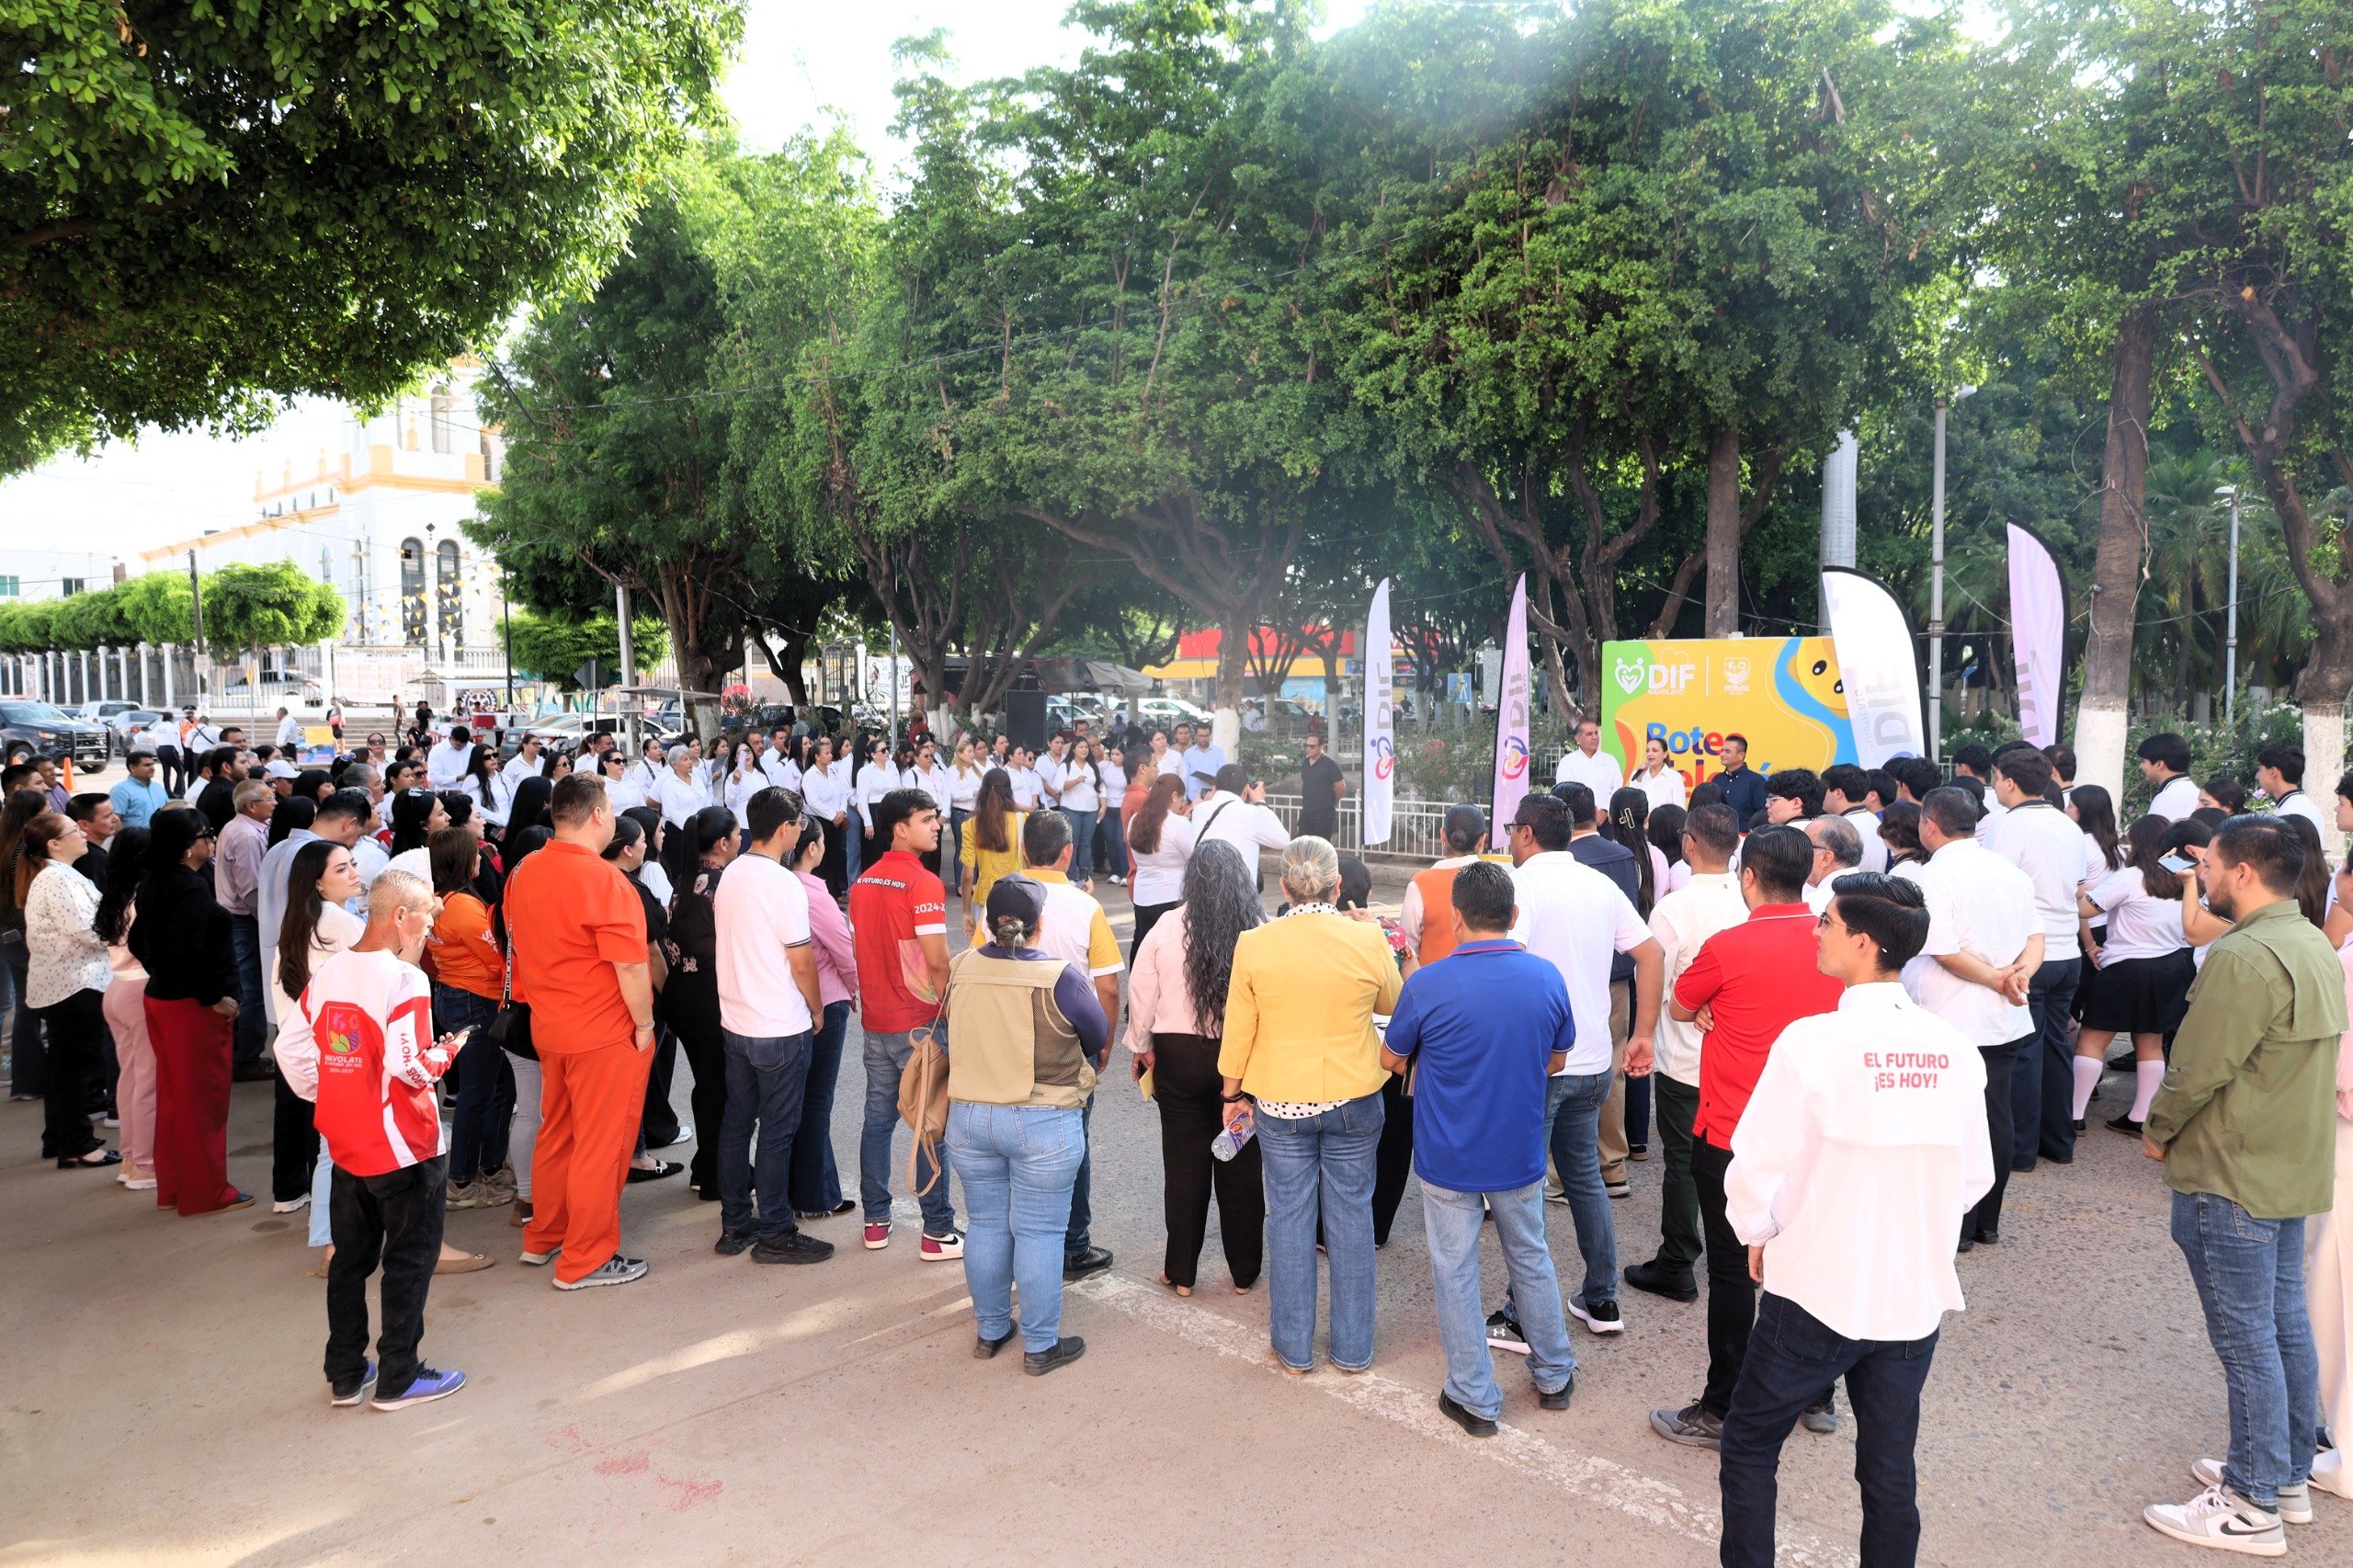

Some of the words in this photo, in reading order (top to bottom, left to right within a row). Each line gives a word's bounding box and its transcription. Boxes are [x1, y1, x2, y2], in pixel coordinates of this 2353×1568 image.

[1648, 664, 1696, 689] DIF
[1647, 722, 1745, 756] Bote
[862, 877, 882, 885] FUTURO
[401, 1032, 412, 1063] HOY!
[324, 1054, 363, 1063] NAVOLATO
[1864, 1052, 1882, 1068] EL
[1886, 1052, 1949, 1069] FUTURO
[1875, 1072, 1895, 1092] ¡ES
[1899, 1072, 1938, 1088] HOY!
